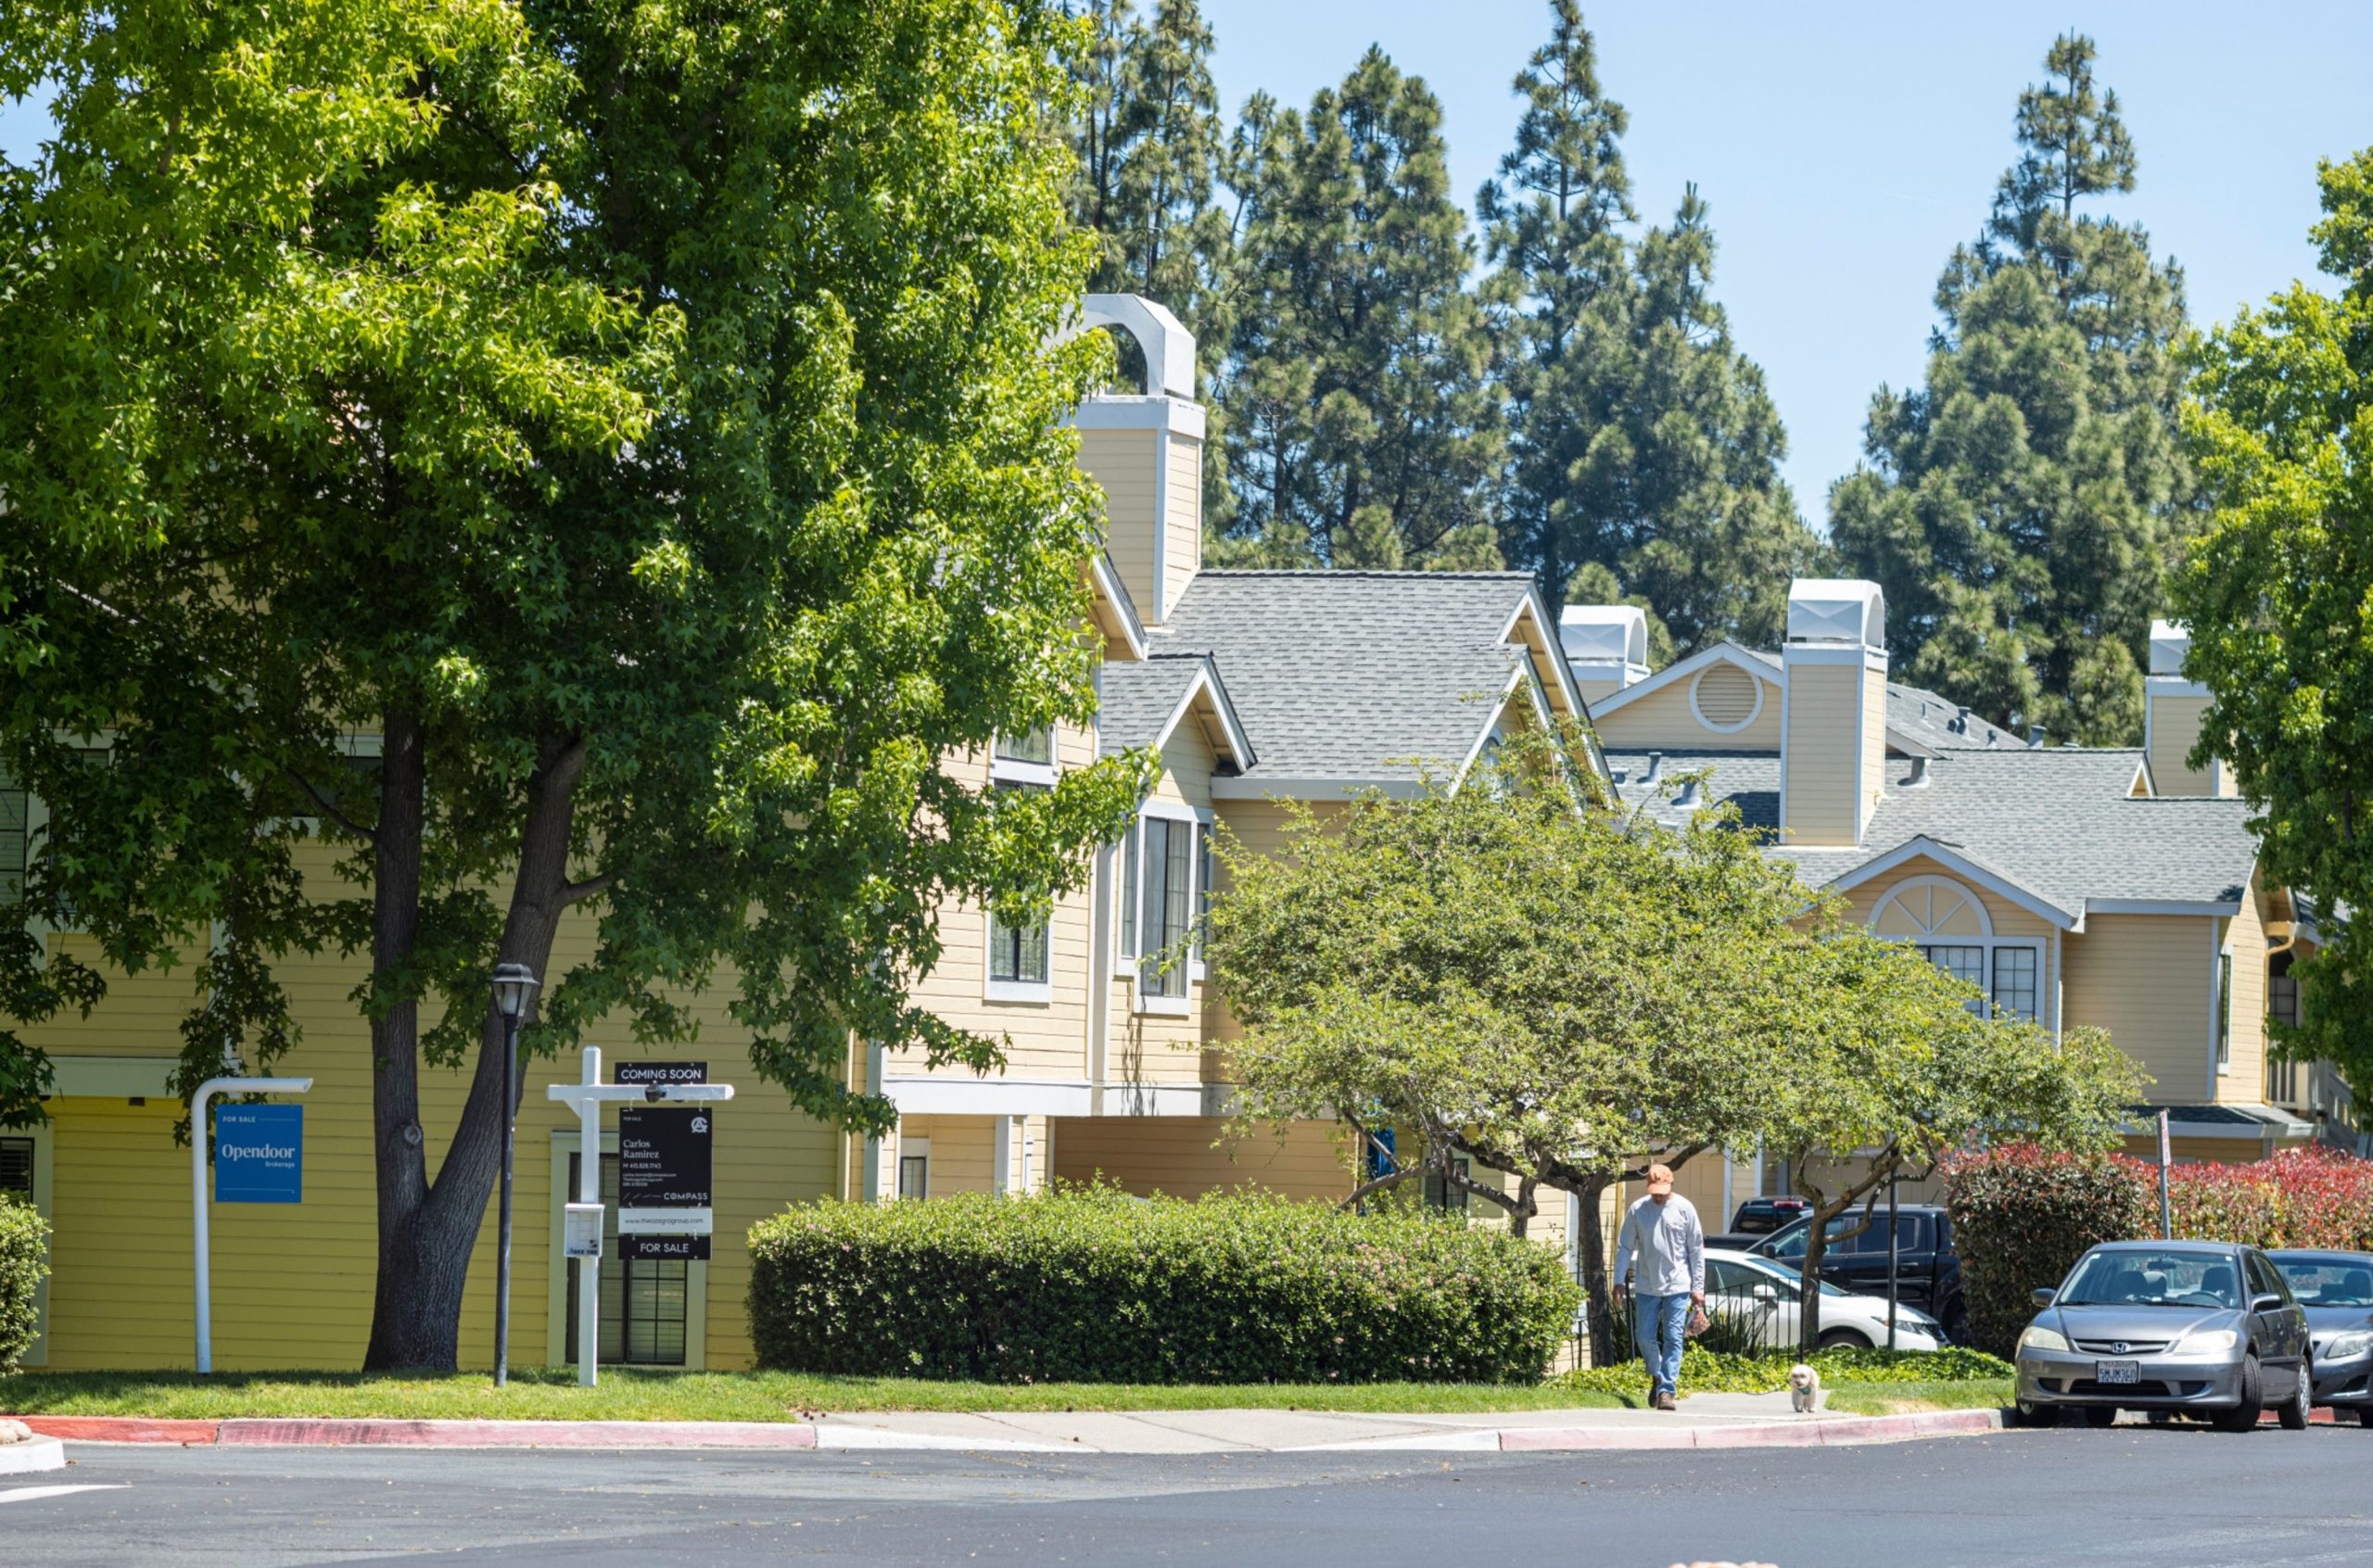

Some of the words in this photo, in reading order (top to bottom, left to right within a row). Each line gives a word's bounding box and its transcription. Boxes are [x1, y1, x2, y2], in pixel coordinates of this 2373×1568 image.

[621, 1069, 666, 1080] COMING
[669, 1069, 702, 1080] SOON
[623, 1139, 651, 1148] Carlos
[222, 1144, 295, 1161] Opendoor
[623, 1149, 659, 1158] Ramirez
[640, 1243, 661, 1253] FOR
[664, 1243, 689, 1253] SALE
